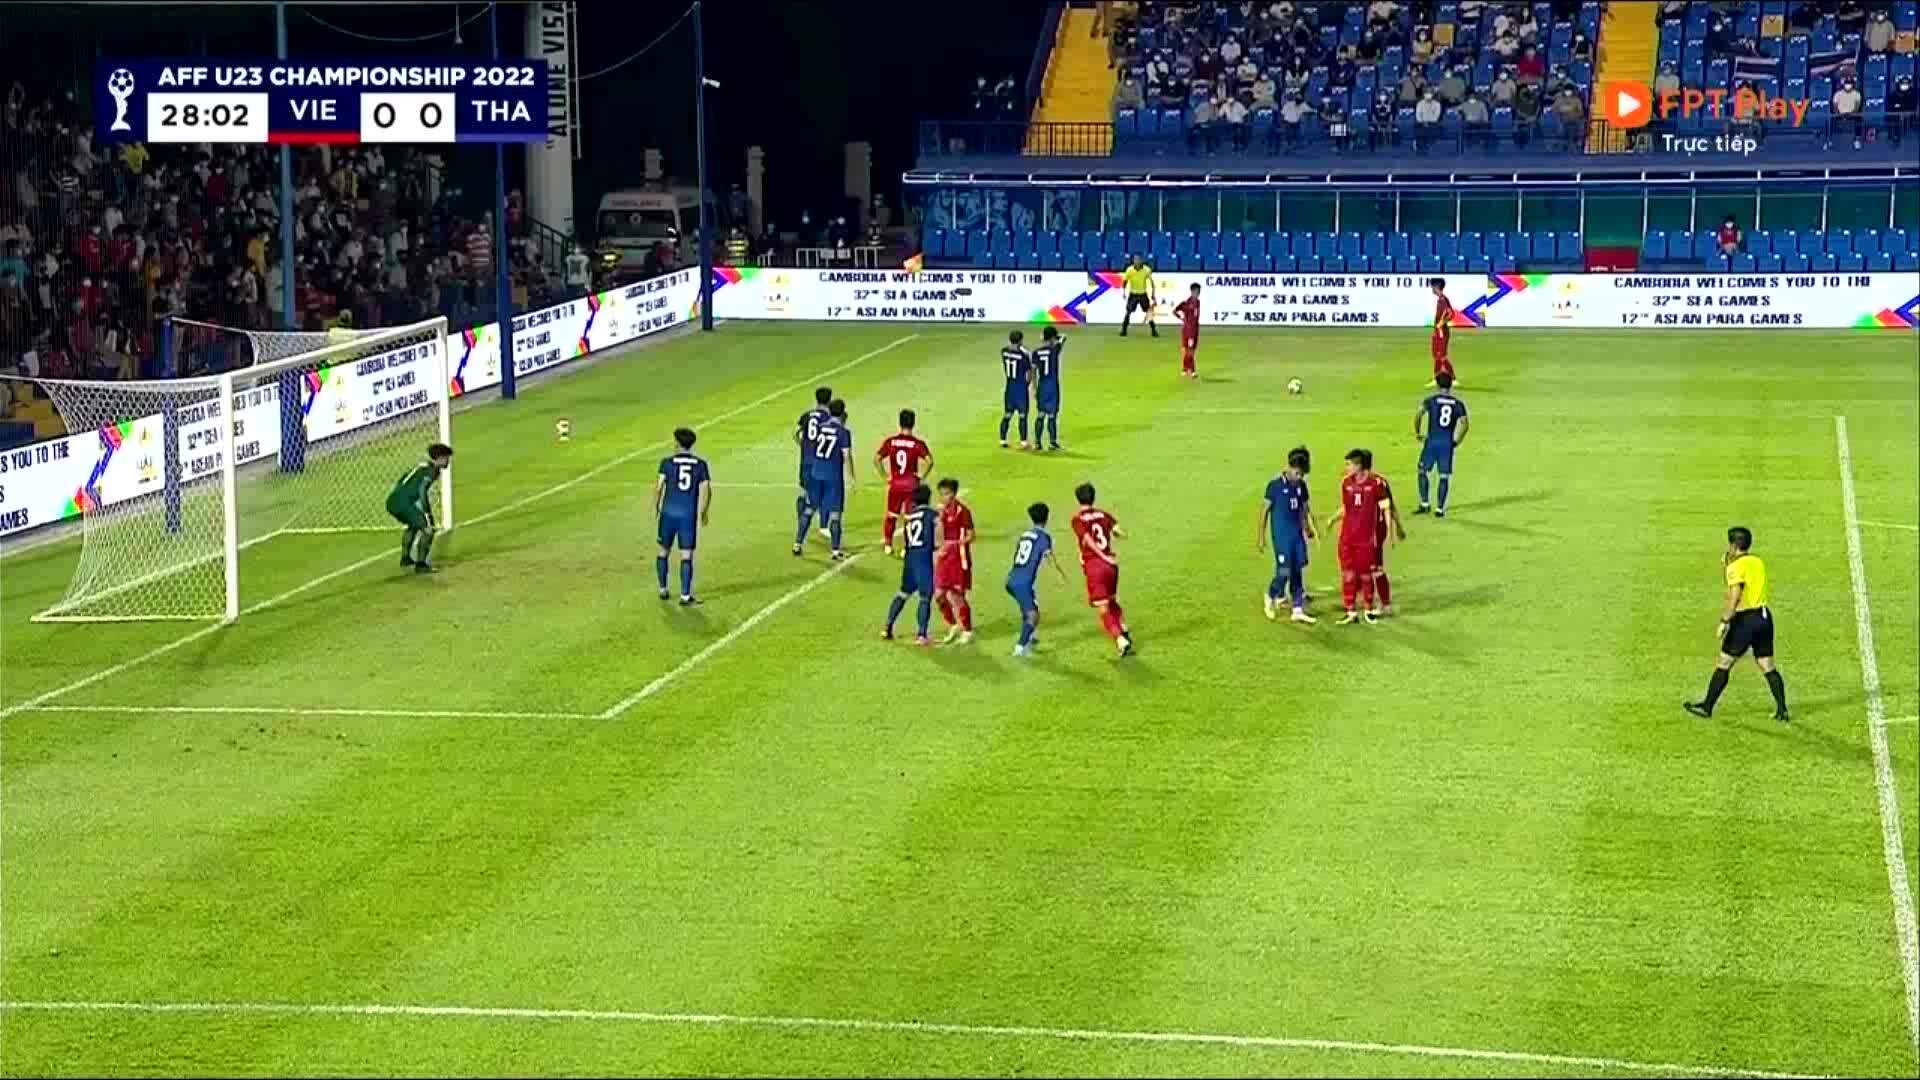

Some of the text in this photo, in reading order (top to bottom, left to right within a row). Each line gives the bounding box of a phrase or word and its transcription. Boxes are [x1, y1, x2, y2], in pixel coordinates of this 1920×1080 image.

[819, 271, 887, 283] CAMBODIA
[970, 273, 996, 285] YOU
[1002, 273, 1017, 285] TO
[1205, 276, 1276, 287] CAMBODIA
[1363, 277, 1390, 288] YOU
[1396, 277, 1413, 288] TO
[1614, 277, 1690, 289] CAMBODIA
[1786, 276, 1816, 288] YOU
[1823, 276, 1840, 288] TO
[1686, 295, 1713, 306] SEA
[1719, 295, 1771, 306] GAMES
[902, 306, 936, 318] PARA
[1292, 311, 1327, 322] PARA
[1654, 313, 1702, 325] ASEAN
[1706, 313, 1744, 325] PARA
[1750, 312, 1803, 325] GAMES
[1039, 355, 1049, 377] 7
[1439, 404, 1453, 428] 8
[807, 417, 819, 441] 6
[11, 449, 32, 471] YOU
[36, 445, 49, 465] TO
[52, 440, 70, 461] THE
[816, 433, 838, 459] 27
[896, 449, 908, 475] 9
[678, 464, 692, 491] 5
[1091, 523, 1108, 551] 3
